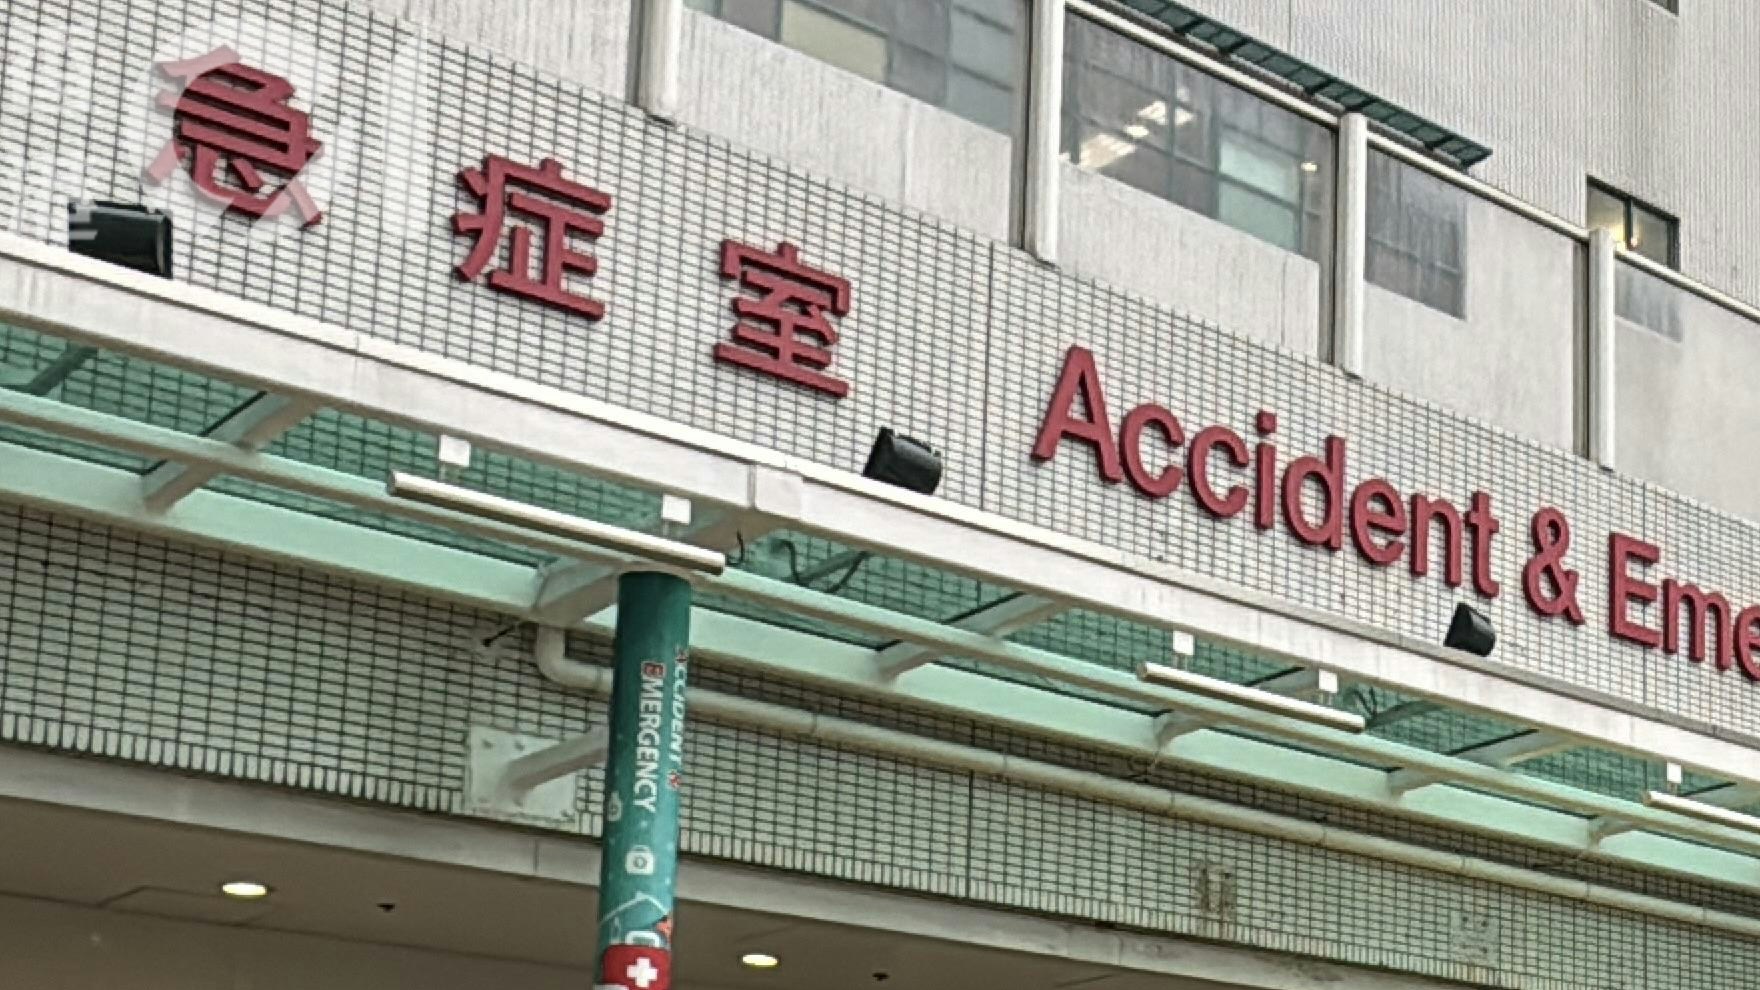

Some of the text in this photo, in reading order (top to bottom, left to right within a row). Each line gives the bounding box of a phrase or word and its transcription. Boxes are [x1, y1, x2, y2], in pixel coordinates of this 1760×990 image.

[143, 44, 851, 399] 急症室
[1030, 342, 1499, 598] Accident
[1522, 506, 1584, 626] &
[633, 660, 667, 813] EMERGENCY
